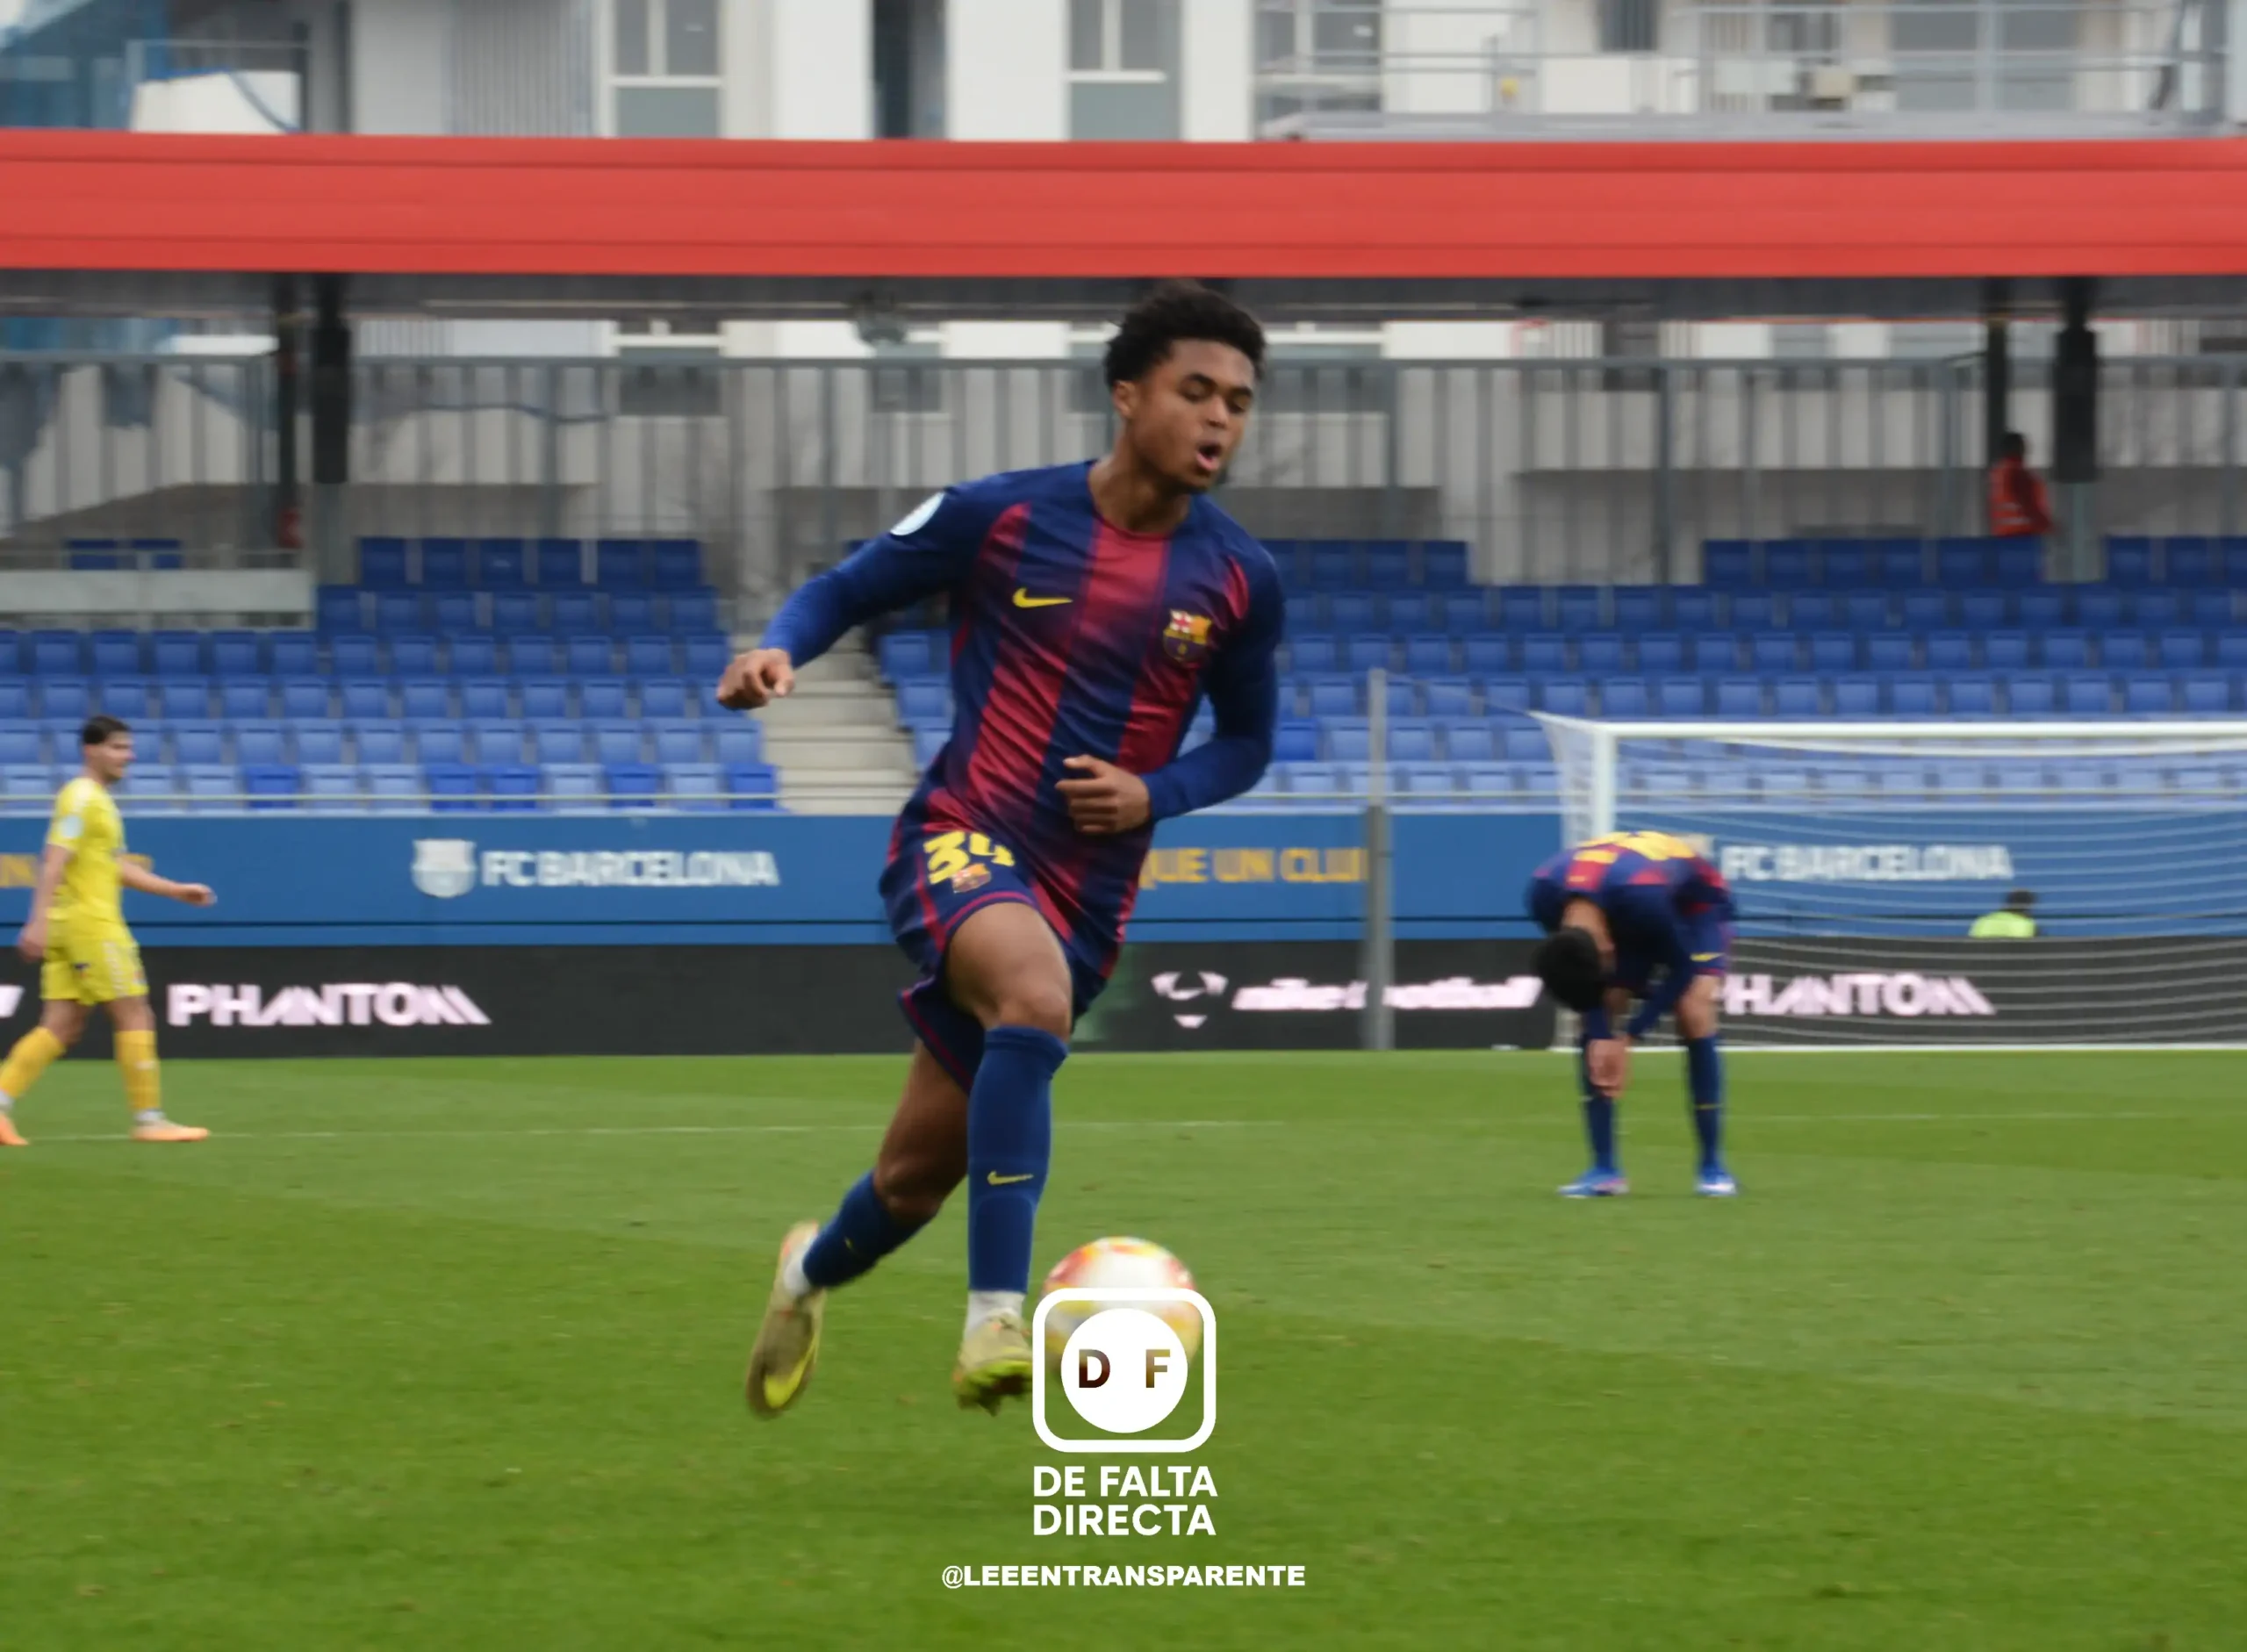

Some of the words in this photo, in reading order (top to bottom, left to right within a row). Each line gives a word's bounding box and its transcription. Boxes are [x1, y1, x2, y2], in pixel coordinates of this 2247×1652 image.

[482, 851, 534, 886] FC
[536, 851, 780, 886] BARCELONA
[1720, 844, 1774, 880] FC
[1776, 844, 2015, 880] BARCELONA
[167, 981, 492, 1026] PHANTOM
[1713, 972, 1998, 1016] HANTOM
